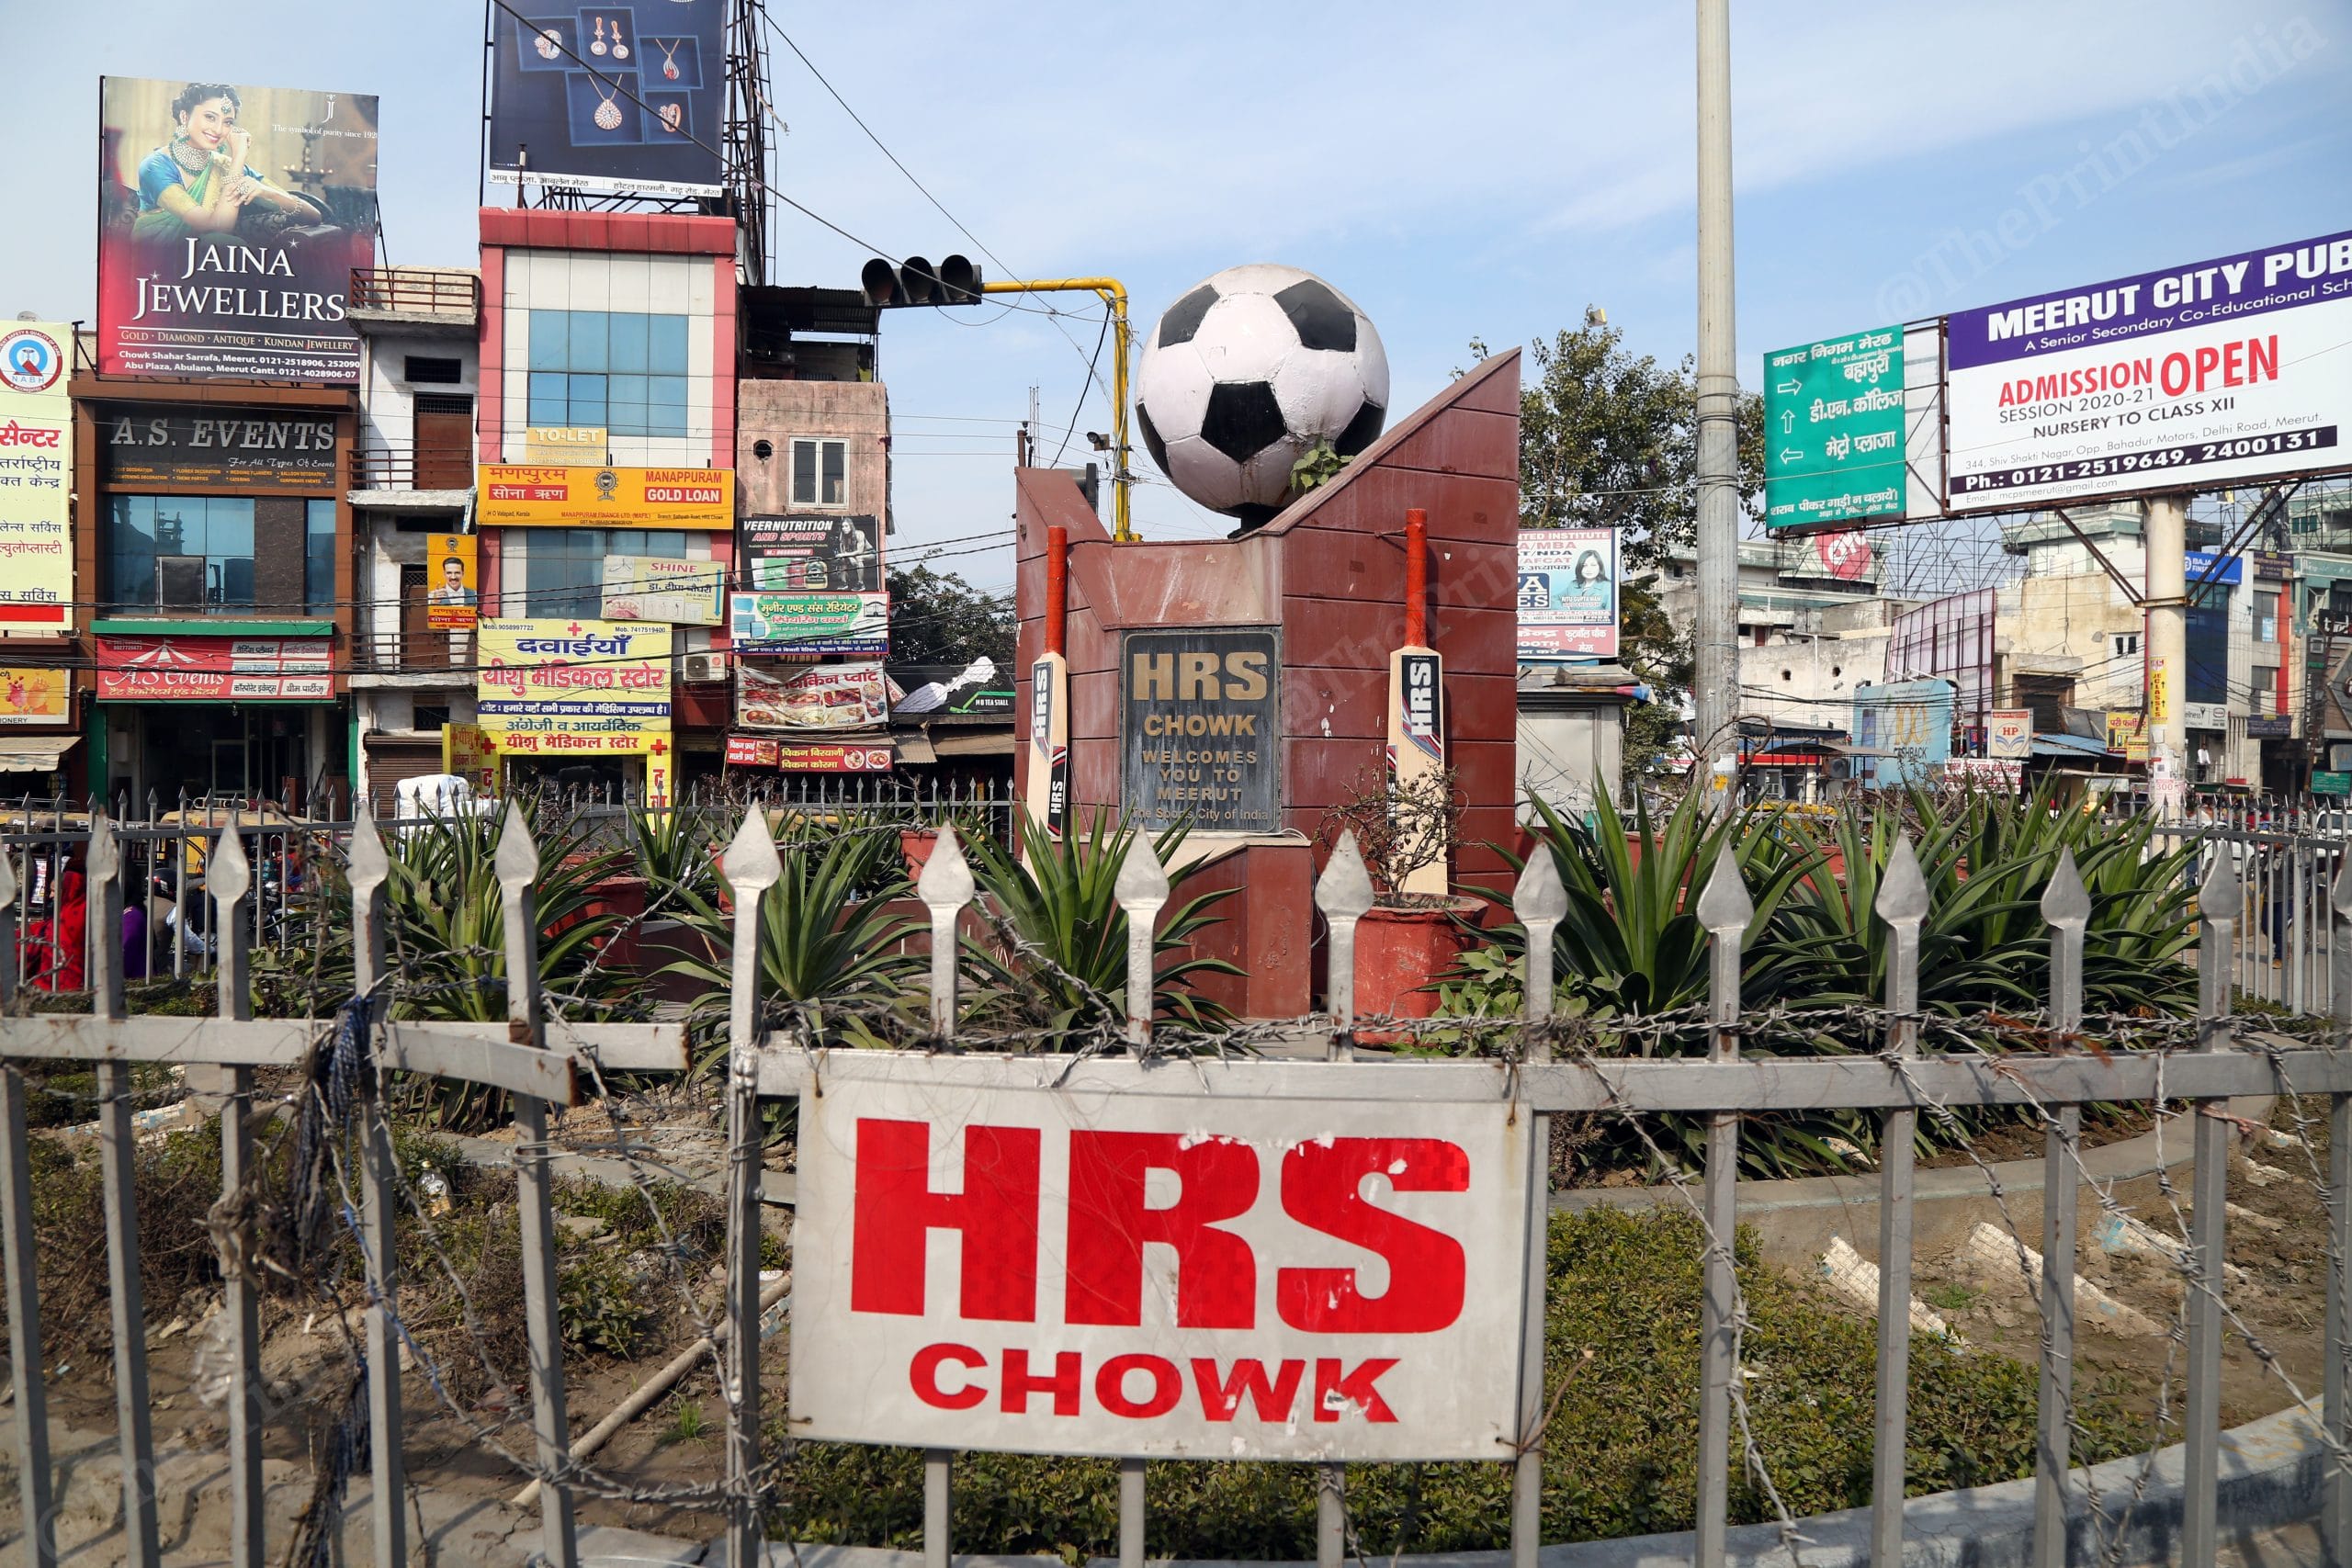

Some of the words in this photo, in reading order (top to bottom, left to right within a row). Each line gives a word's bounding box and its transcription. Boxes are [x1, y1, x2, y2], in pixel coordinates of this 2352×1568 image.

[288, 126, 312, 135] symbol
[322, 130, 343, 138] purity
[182, 237, 295, 279] JAINA
[132, 277, 346, 321] JEWELLERS
[1987, 284, 2141, 343] MEERUT
[2153, 260, 2251, 310] CITY
[2263, 237, 2352, 288] PUB
[2024, 339, 2037, 353] A
[2040, 331, 2088, 349] Senior
[2092, 317, 2175, 340] Secondary
[2178, 285, 2316, 323] Co-Educational
[2322, 277, 2352, 296] Sch
[120, 330, 149, 341] GOLD
[158, 332, 205, 344] DIAMOND
[213, 333, 255, 346] ANTIQUE
[264, 336, 304, 348] KUNDAN
[306, 339, 354, 351] JEWELLERY
[1772, 351, 1807, 367] नगर
[1810, 341, 1855, 360] निगम
[1858, 333, 1893, 349] मेरठ
[119, 350, 150, 360] Chowk
[152, 351, 184, 361] Shahar
[186, 352, 220, 363] Sarrafa,
[222, 354, 258, 364] Meerut.
[124, 361, 143, 371] Abu
[145, 361, 173, 372] Plaza,
[174, 362, 213, 373] Abulane,
[216, 364, 249, 374] Meerut
[250, 366, 277, 375] Cantt.
[278, 367, 356, 378] 0121-4028906-07
[1998, 357, 2153, 408] ADMISSION
[2160, 334, 2278, 397] OPEN
[12, 376, 45, 384] NABH
[1810, 398, 1852, 423] डी.एन.
[1853, 387, 1904, 413] कॉलिज
[1999, 400, 2073, 423] SESSION
[2079, 388, 2154, 412] 2020-21
[2033, 416, 2111, 439] NURSERY
[2117, 412, 2142, 427] TO
[2148, 401, 2205, 423] CLASS
[2211, 397, 2235, 413] XII
[110, 417, 176, 447] A.S.
[188, 419, 334, 451] EVENTS
[1965, 459, 1986, 470] 344,
[1989, 456, 2008, 467] Shiv
[2010, 452, 2039, 464] Shakti
[2041, 447, 2074, 460] Nagar,
[2076, 445, 2103, 457] Opp.
[2107, 436, 2154, 451] Bahadur
[2156, 431, 2199, 445] Motors,
[2202, 424, 2233, 438] Delhi
[2236, 419, 2271, 433] Road,
[2276, 412, 2323, 427] Meerut.
[1826, 433, 1850, 460] मेट्रो
[1854, 431, 1897, 453] प्लाजा
[228, 457, 247, 468] For
[248, 458, 264, 468] All
[266, 457, 293, 468] Types
[297, 458, 310, 468] Of
[311, 459, 335, 468] Events
[1966, 475, 2005, 491] Ph.:
[2011, 448, 2192, 485] 0121-2519649,
[2201, 430, 2318, 461] 2400131
[645, 470, 722, 484] MANAPPURAM
[492, 485, 526, 500] सोना
[534, 488, 565, 501] ऋण
[647, 489, 683, 502] GOLD
[685, 490, 719, 502] LOAN
[1999, 479, 2118, 502] mcpsmeerut@gmail.com
[1798, 499, 1826, 512] पीकर
[1826, 493, 1850, 510] गाड़ी
[1852, 495, 1863, 504] न
[29, 519, 62, 534] सर्विस
[743, 520, 833, 531] VEERNUTRITION
[752, 532, 779, 542] AND
[780, 531, 827, 542] SPORTS
[1548, 532, 1610, 540] INSTITUTE
[650, 562, 698, 573] SHINE
[20, 587, 57, 602] सर्विस
[786, 604, 806, 614] एण्ड
[807, 602, 823, 614] संस
[515, 633, 633, 657] दवाईयाँ
[482, 657, 527, 698] यीशु
[618, 660, 666, 690] स्टोर
[1133, 651, 1268, 701] HRS
[1035, 669, 1048, 739] HRS
[1409, 661, 1433, 736] HRS
[503, 702, 524, 712] हमारे
[525, 702, 541, 713] यहाँ
[541, 702, 559, 713] सभी
[560, 704, 581, 715] प्रकार
[582, 703, 594, 713] की
[505, 717, 553, 731] अंग्रेजी
[557, 721, 569, 731] व
[1144, 714, 1257, 737] CHOWK
[2002, 727, 2018, 736] HP
[505, 733, 539, 752] यीशु
[608, 734, 640, 749] स्टोर
[781, 747, 808, 757] चिकन
[810, 747, 844, 757] बिरयानी
[781, 760, 808, 769] चिकन
[810, 760, 839, 769] कोरमा
[1142, 750, 1258, 764] WELCOMES
[1160, 769, 1201, 783] YOU
[1212, 769, 1240, 783] TO
[1050, 781, 1064, 814] HRS
[1158, 787, 1242, 802] MEERUT
[1198, 807, 1221, 822] City
[1224, 808, 1238, 820] of
[851, 1117, 1472, 1335] HRS
[908, 1341, 1401, 1424] CHOWK
